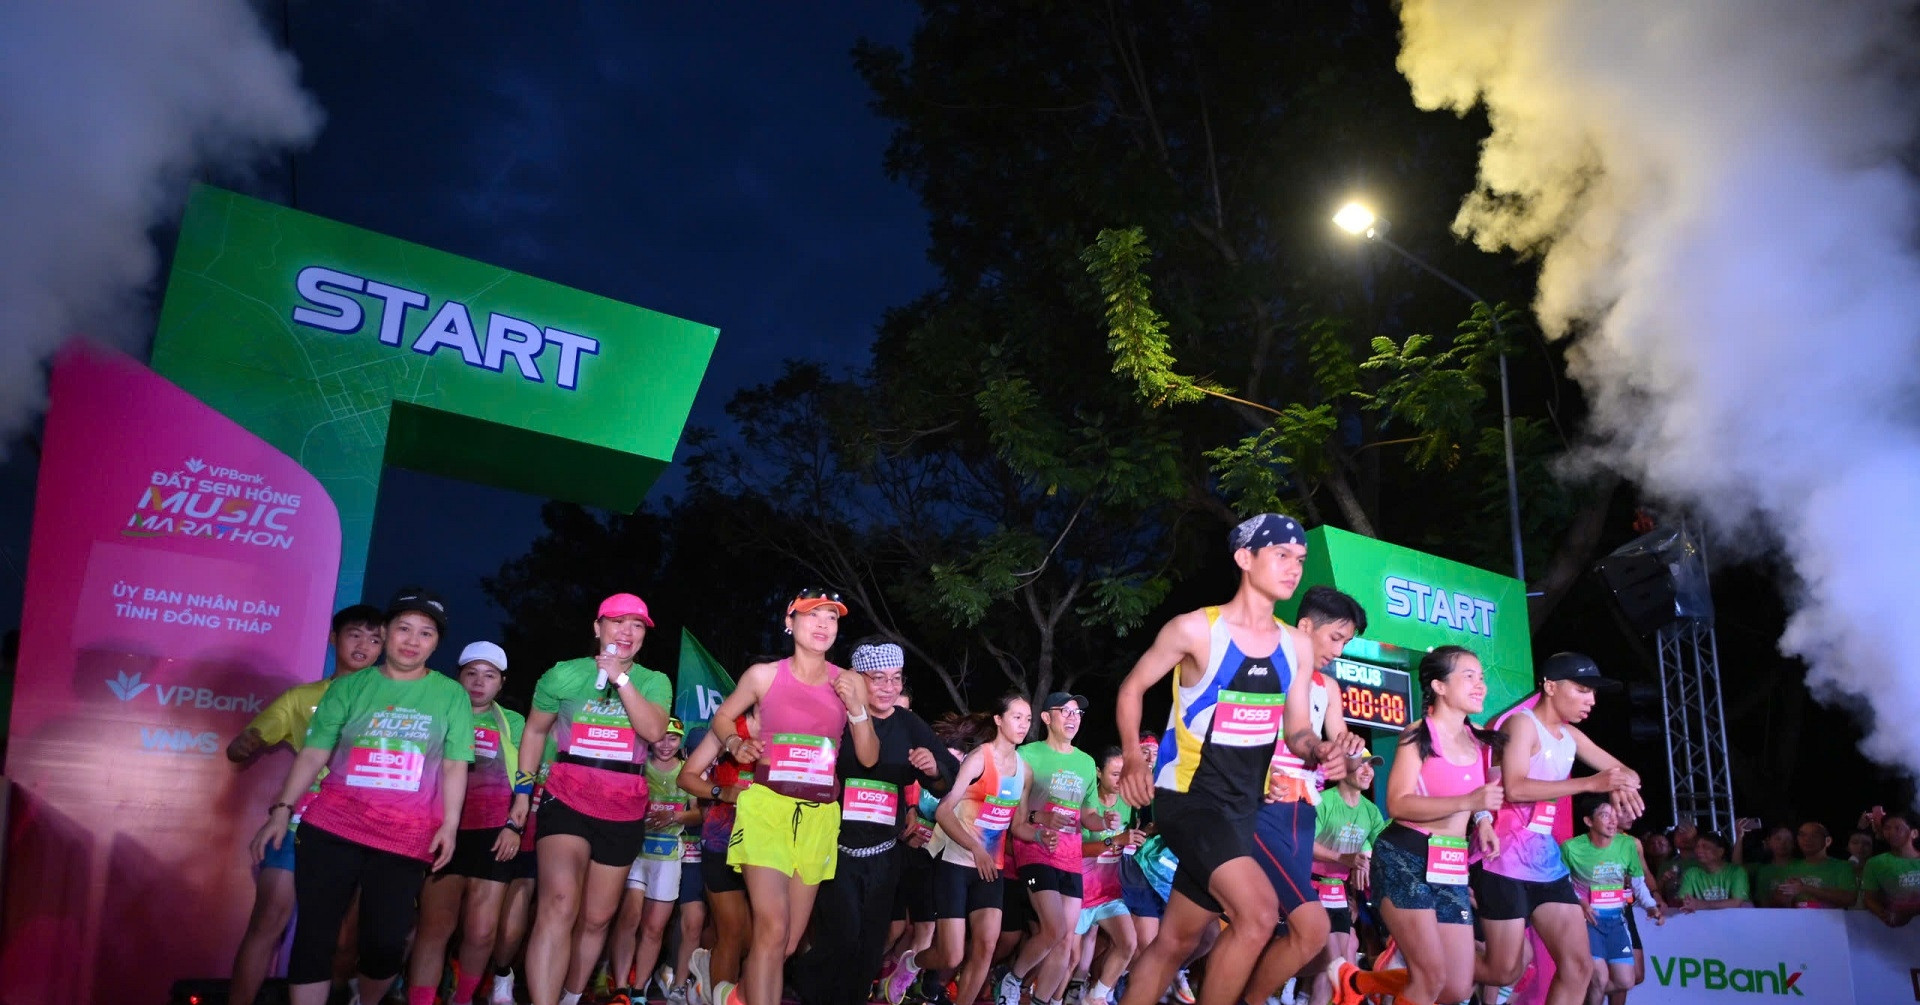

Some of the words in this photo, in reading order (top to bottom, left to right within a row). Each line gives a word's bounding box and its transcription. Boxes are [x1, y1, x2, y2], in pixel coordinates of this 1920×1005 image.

[293, 265, 600, 391] START
[151, 471, 195, 488] ĐẤT
[198, 479, 242, 497] SEN
[245, 485, 301, 507] HỒNG
[209, 465, 264, 485] VPBank
[138, 487, 298, 531] MUSIC
[127, 513, 295, 549] MARATHON
[113, 580, 139, 598] ỦY
[144, 588, 182, 605] BAN
[187, 592, 239, 611] NHÂN
[242, 597, 281, 617] DÂN
[1385, 575, 1495, 637] START
[116, 601, 157, 621] TỈNH
[163, 607, 221, 629] ĐỒNG
[227, 615, 272, 634] THÁP
[1335, 661, 1382, 687] NEXUS
[155, 684, 264, 713] VPBank
[140, 728, 219, 753] VNMS
[368, 718, 432, 732] MUSIC
[857, 791, 889, 803] 10597
[1650, 955, 1804, 996] VPBank
